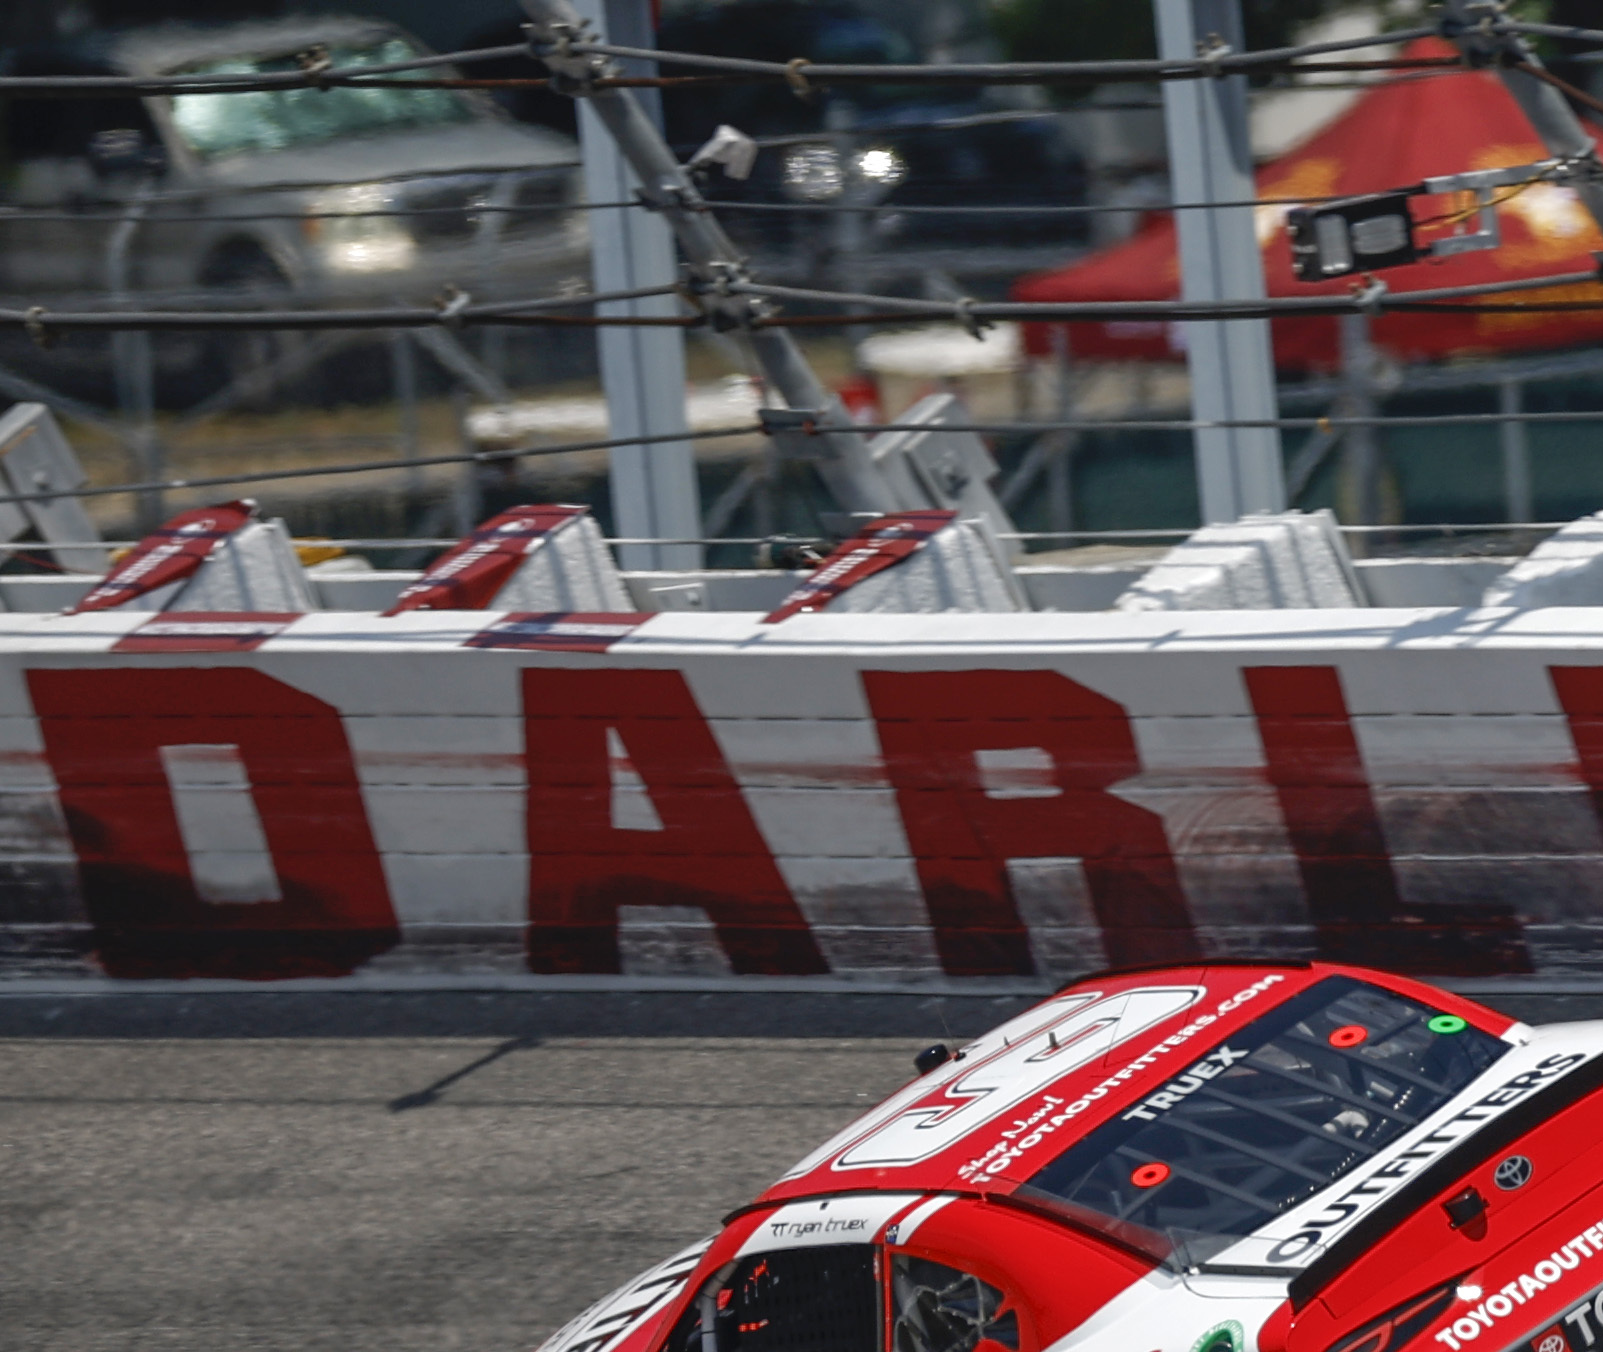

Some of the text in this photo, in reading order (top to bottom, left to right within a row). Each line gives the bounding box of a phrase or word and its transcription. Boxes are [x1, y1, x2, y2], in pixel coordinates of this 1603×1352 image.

[970, 974, 1284, 1184] TOYOTAOUTFITTERS.COM
[1122, 1043, 1249, 1124] TRUEX
[958, 1094, 1065, 1180] Shop Now!
[1265, 1051, 1588, 1265] OUTFITTERS
[788, 1222, 822, 1238] ryan
[825, 1217, 871, 1232] truex
